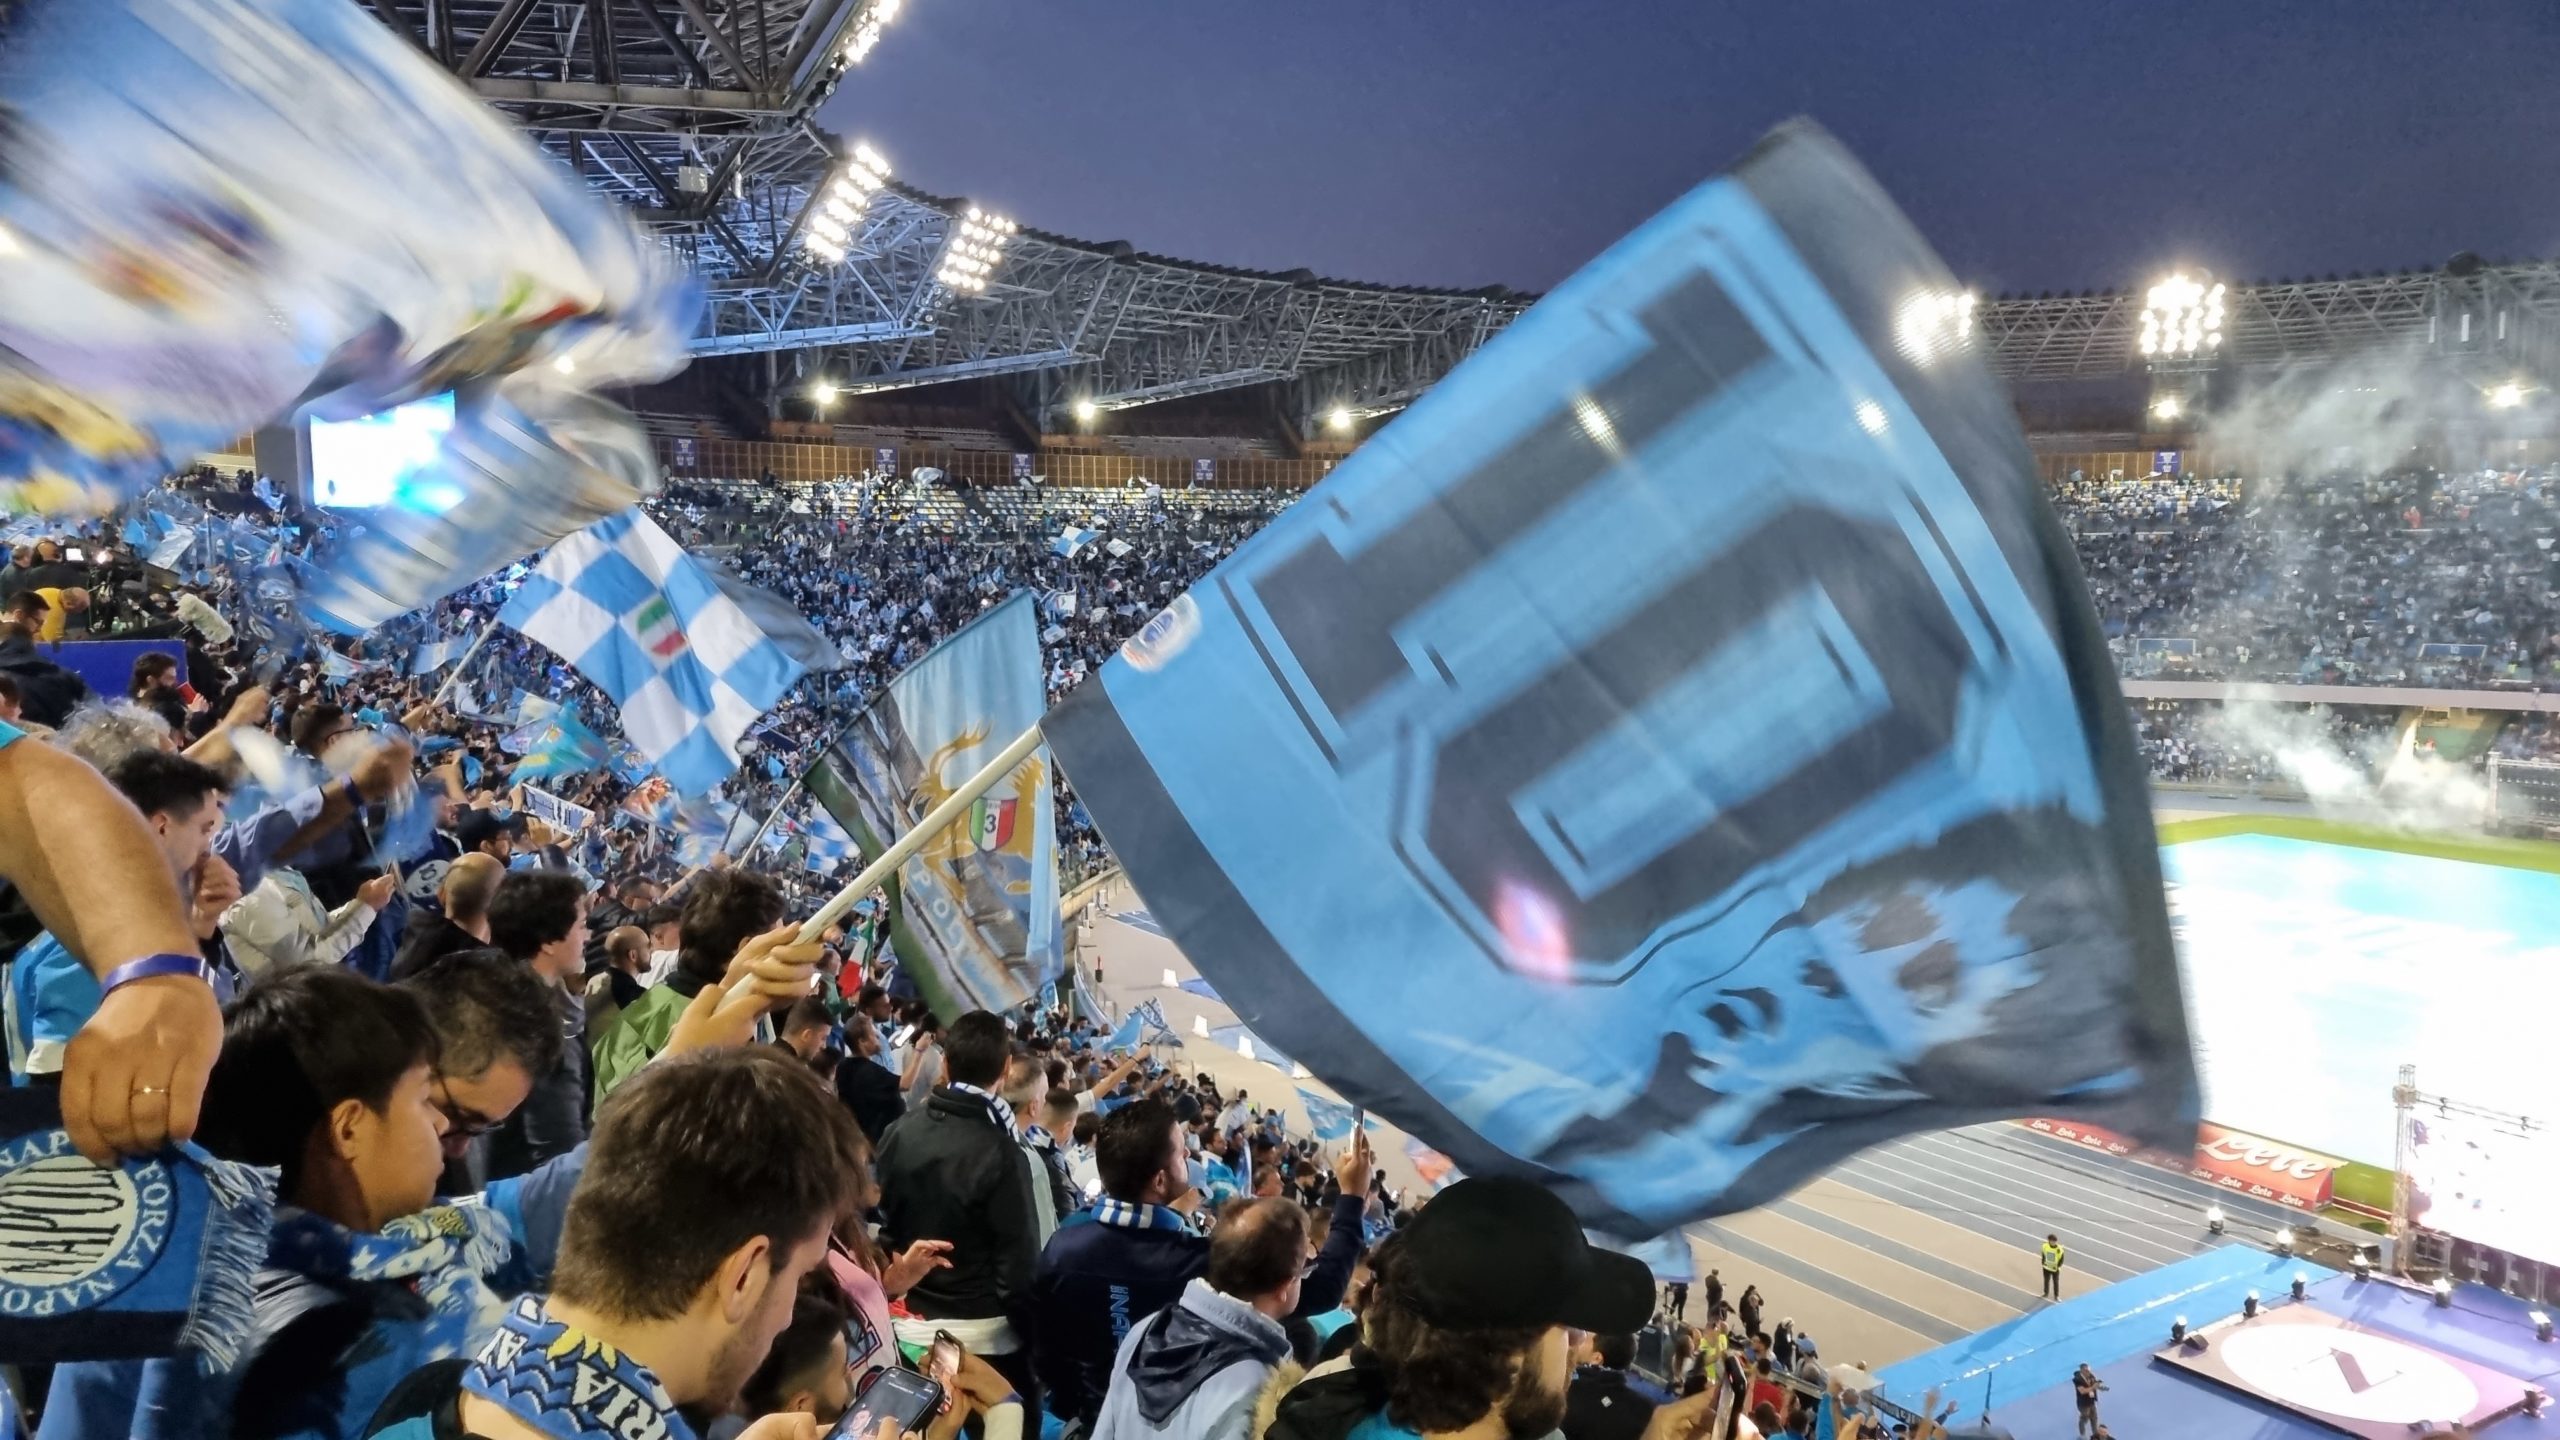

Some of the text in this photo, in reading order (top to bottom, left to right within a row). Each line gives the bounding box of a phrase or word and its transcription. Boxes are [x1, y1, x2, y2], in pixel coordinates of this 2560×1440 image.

[1225, 240, 1995, 980] 10
[984, 813, 997, 834] 3
[2195, 1135, 2327, 1180] Lete
[115, 1161, 171, 1270] FORZA
[0, 1275, 117, 1317] NAPO
